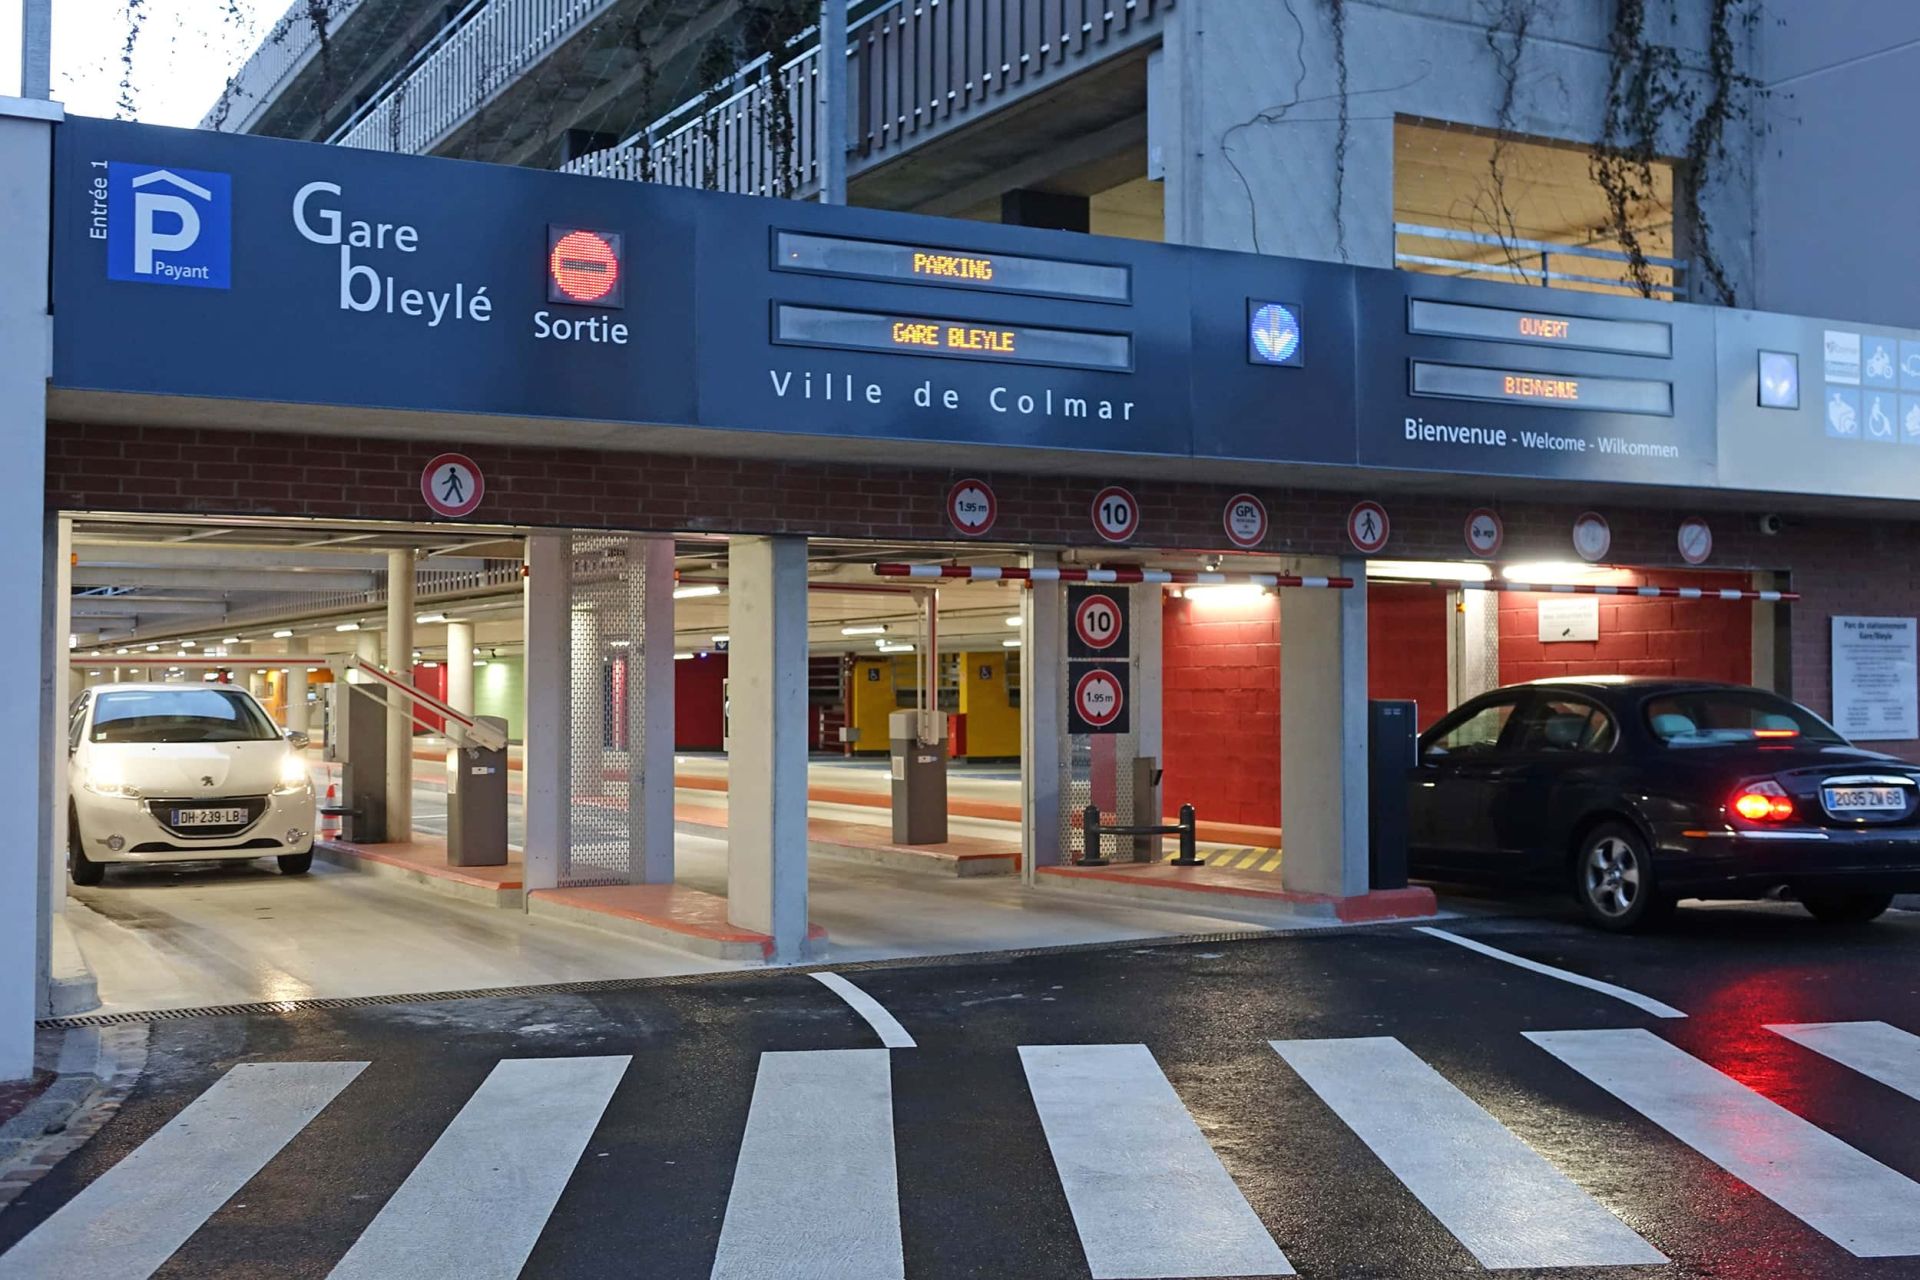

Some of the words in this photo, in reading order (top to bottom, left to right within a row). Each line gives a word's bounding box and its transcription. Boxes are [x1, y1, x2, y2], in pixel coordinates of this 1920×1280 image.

[90, 160, 108, 169] 1
[88, 177, 107, 239] Entrée
[292, 181, 419, 252] Gare
[134, 192, 200, 274] P
[155, 261, 209, 280] Payant
[913, 253, 993, 280] PARKING
[340, 244, 493, 327] bleylé
[533, 311, 629, 344] Sortie
[892, 322, 939, 346] GARE
[947, 326, 1015, 352] BLEYLE
[1519, 317, 1570, 339] OUVERT
[769, 370, 882, 403] Ville
[913, 381, 959, 409] de
[989, 387, 1134, 420] Colmar
[1504, 376, 1579, 399] BIENVENUE
[1404, 418, 1507, 447] Bienvenue
[1520, 431, 1586, 451] Welcome
[1598, 437, 1679, 458] Wilkommen
[978, 505, 988, 513] m
[1102, 503, 1128, 525] 10
[1235, 505, 1257, 518] GPL
[1087, 611, 1111, 632] 10
[1086, 692, 1104, 702] 1.95
[1835, 791, 1866, 806] 2035
[1886, 791, 1902, 805] 68
[181, 810, 240, 824] DH-239-LB
